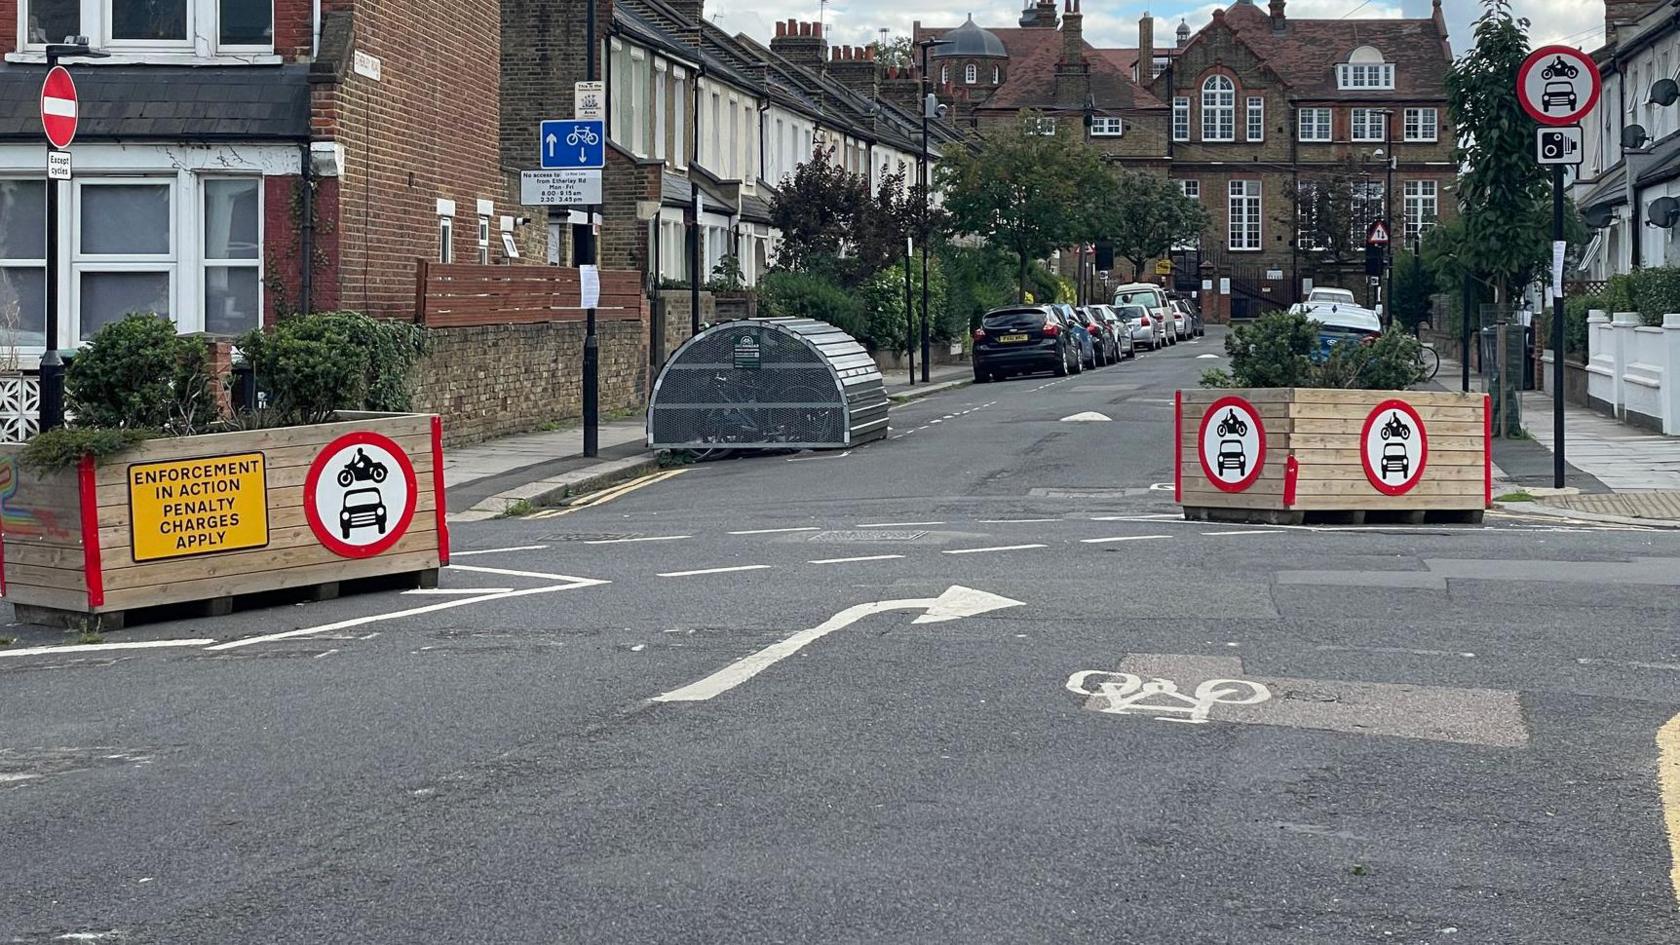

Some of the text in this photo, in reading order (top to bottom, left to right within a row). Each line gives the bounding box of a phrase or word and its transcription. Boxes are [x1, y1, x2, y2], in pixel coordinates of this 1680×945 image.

[50, 155, 69, 165] Except
[134, 460, 259, 485] ENFORCEMENT
[156, 478, 240, 499] IN ACTION
[163, 497, 235, 517] PENALTY
[160, 513, 239, 534] CHARGES
[176, 531, 225, 549] APPLY
